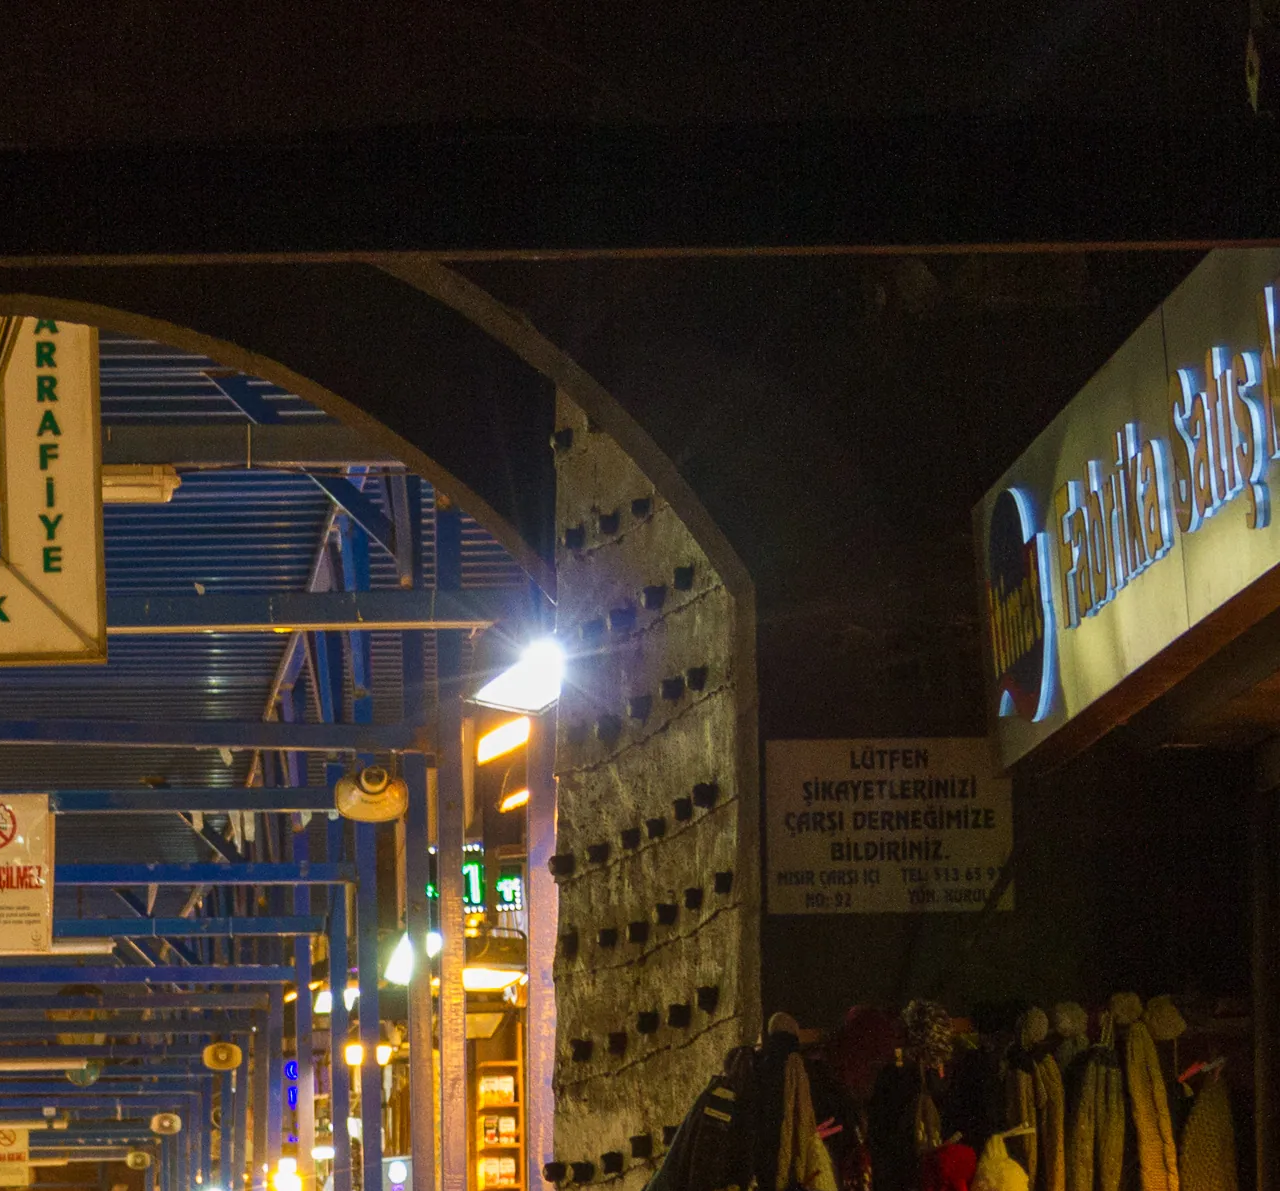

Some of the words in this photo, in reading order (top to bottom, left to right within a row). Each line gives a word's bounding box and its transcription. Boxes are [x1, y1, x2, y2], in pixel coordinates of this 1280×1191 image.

[1054, 421, 1175, 630] Fabrika
[1170, 346, 1270, 533] Satış
[850, 745, 930, 770] LÜTFEN
[802, 775, 977, 806] ŞİKAYETLERİNİZİ
[785, 810, 845, 838] ÇARŞI
[853, 805, 996, 831] DERNEĞİMİZE
[830, 836, 950, 862] BİLDİRİNİZ.
